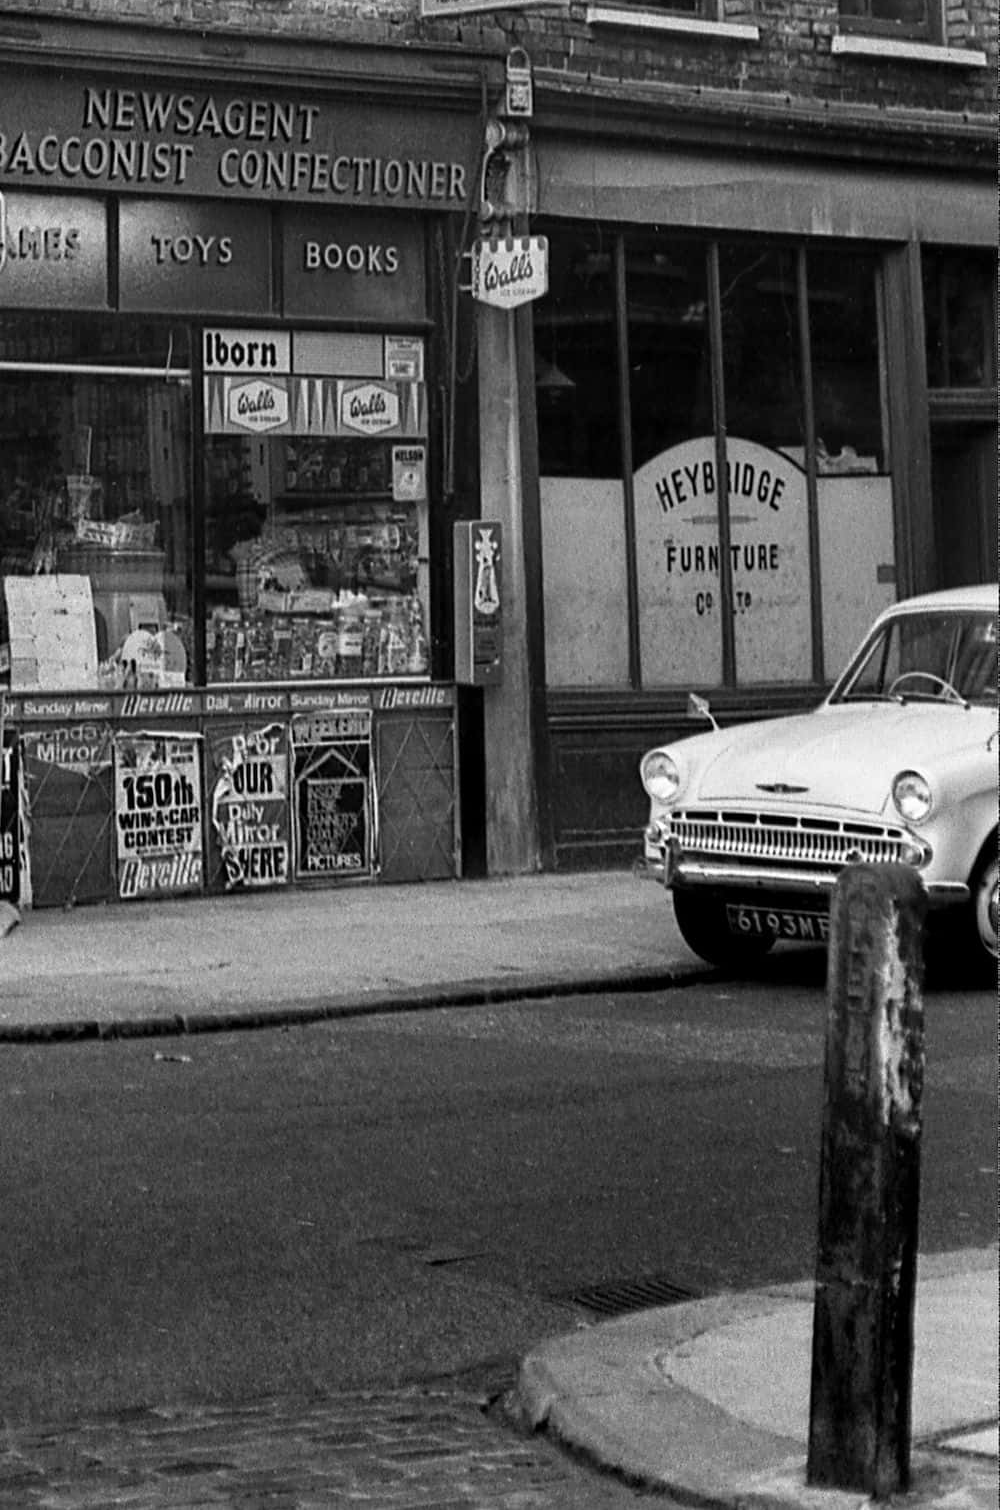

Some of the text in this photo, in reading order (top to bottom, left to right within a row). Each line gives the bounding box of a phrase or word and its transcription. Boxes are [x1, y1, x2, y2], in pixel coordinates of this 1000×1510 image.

[85, 87, 320, 141] NEWSAGENT
[218, 148, 467, 199] CONFECTIONER
[7, 225, 81, 260] MES
[152, 235, 233, 264] TOYS
[305, 242, 399, 273] BOOKS
[206, 332, 277, 367] lborn
[667, 543, 780, 573] FURNTURE
[24, 701, 72, 717] Sunday
[75, 700, 110, 714] Mirror
[290, 692, 370, 708] Sunday Mirror
[37, 742, 99, 763] Mirror
[122, 772, 194, 811] 150th
[124, 826, 194, 849] CONTEST
